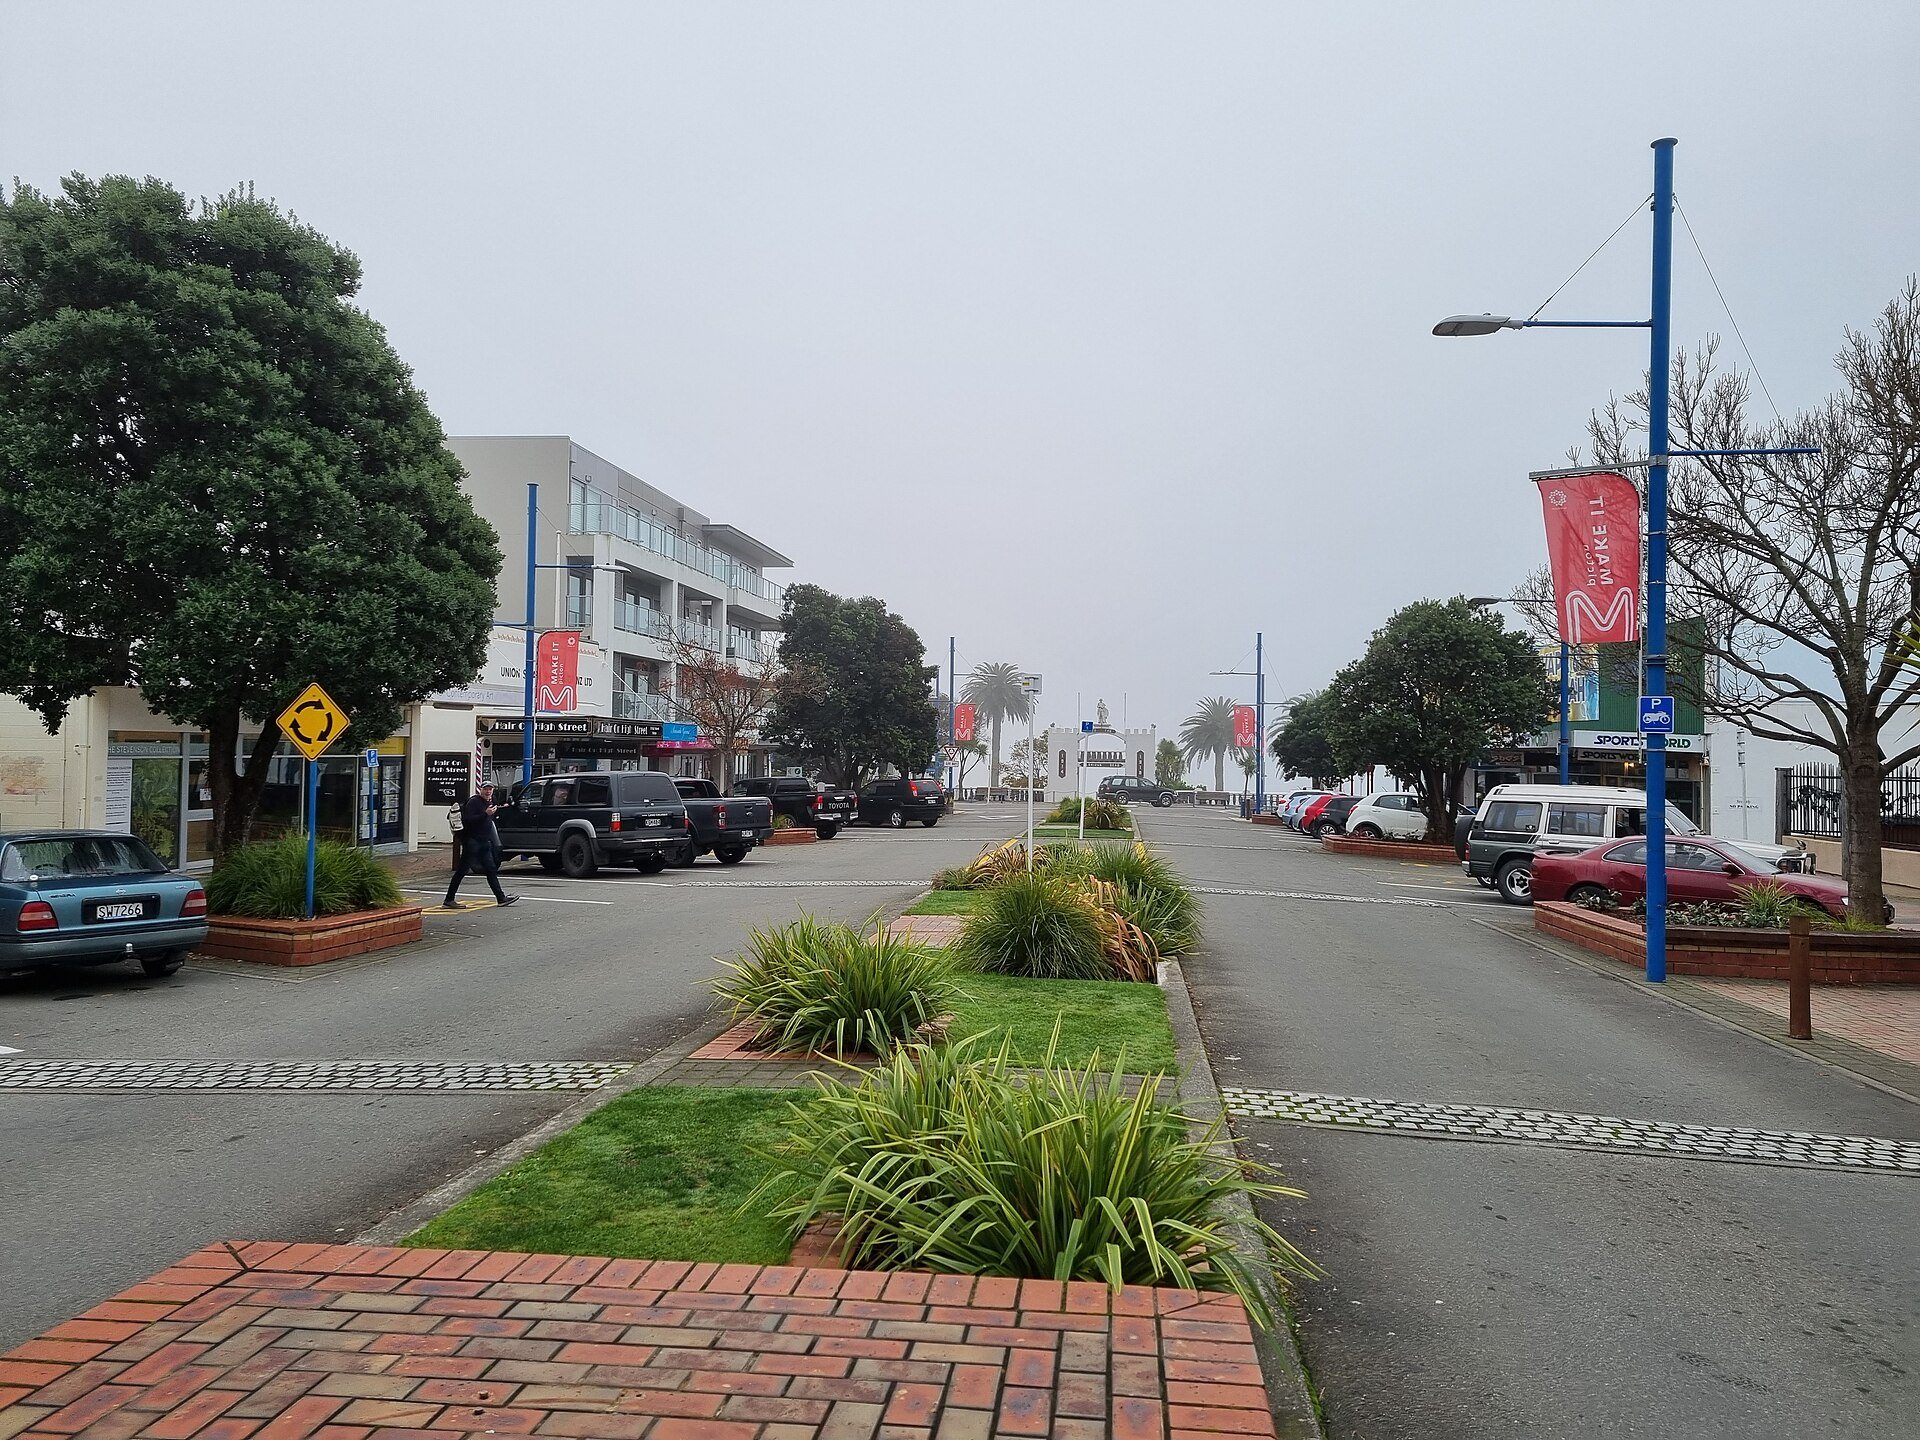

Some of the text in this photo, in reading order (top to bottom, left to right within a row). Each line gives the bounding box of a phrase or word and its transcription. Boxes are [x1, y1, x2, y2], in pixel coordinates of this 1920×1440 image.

[551, 642, 560, 685] MAKE IT
[500, 667, 521, 678] UNION
[585, 678, 593, 686] LTD
[446, 690, 494, 701] Contemporary Art
[1651, 699, 1661, 710] P
[495, 722, 516, 730] Hair
[535, 722, 587, 731] High Street
[601, 723, 613, 733] Hair
[634, 726, 648, 735] Street
[1594, 735, 1691, 748] SPORTS ORLD
[1580, 751, 1618, 760] SPORTS
[828, 802, 850, 810] TOYOTA
[98, 903, 142, 918] SW7266
